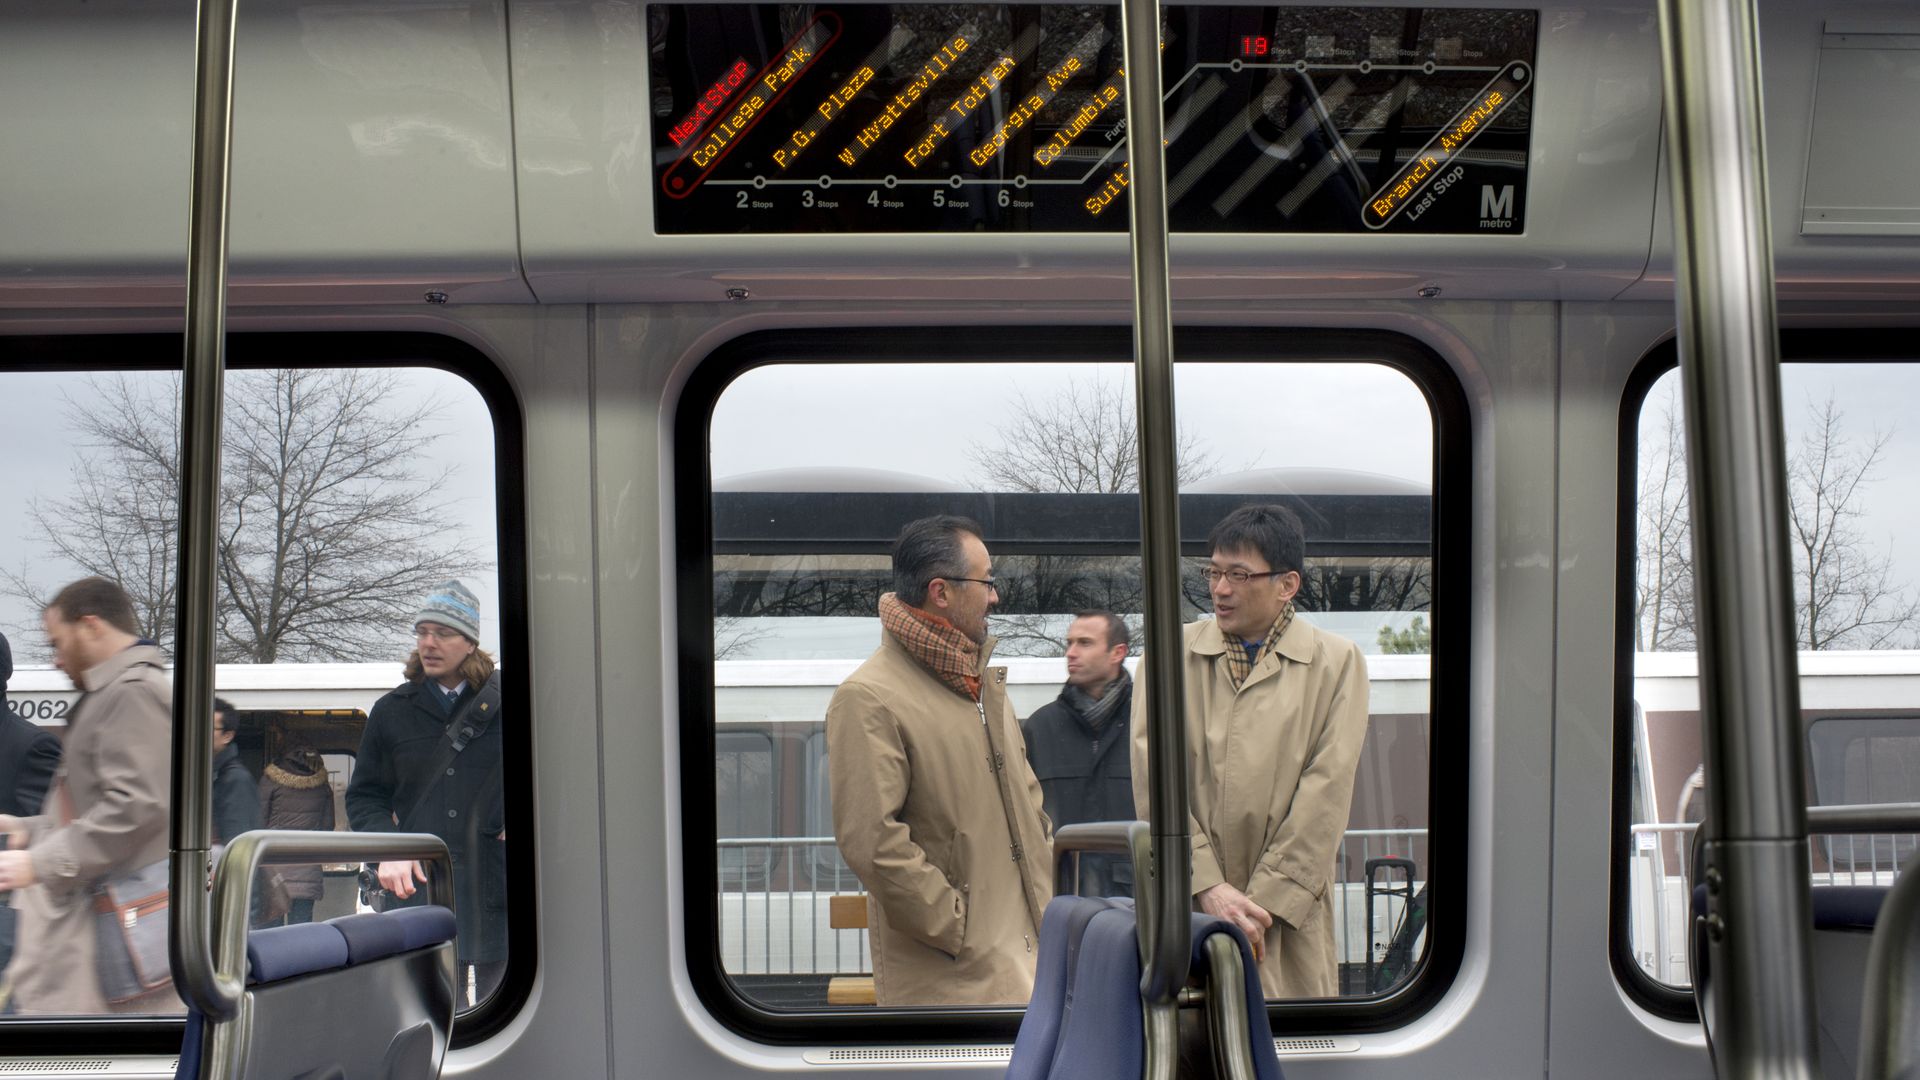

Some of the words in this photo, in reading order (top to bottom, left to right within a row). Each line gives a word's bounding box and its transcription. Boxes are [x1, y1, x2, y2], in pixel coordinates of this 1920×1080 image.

[1243, 37, 1268, 55] 19
[692, 95, 765, 168] College
[764, 47, 811, 92] Park
[773, 130, 816, 168] P.G.
[818, 66, 875, 121] Plaza
[838, 148, 856, 167] W
[857, 37, 969, 148] Hyattsville
[904, 122, 949, 168] Fort
[950, 57, 1016, 117] Totten
[970, 95, 1044, 167] Georgia
[1046, 57, 1081, 92] Ave
[1036, 86, 1119, 166] Columbia
[1104, 118, 1128, 141] Furth
[1373, 156, 1438, 217] Branch
[1441, 91, 1504, 153] Avenue
[736, 190, 749, 208] 2
[752, 200, 774, 209] Stops
[802, 190, 815, 208] 3
[817, 200, 839, 209] Stops
[867, 190, 880, 208] 4
[882, 200, 904, 208] Stops
[932, 190, 945, 208] 5
[948, 200, 970, 208] Stops
[997, 189, 1010, 207] 6
[1012, 199, 1034, 208] Stops
[1086, 163, 1130, 214] Suit
[1406, 192, 1437, 221] Last
[1434, 165, 1465, 196] Stop
[1480, 184, 1515, 219] M
[1479, 218, 1512, 229] metro
